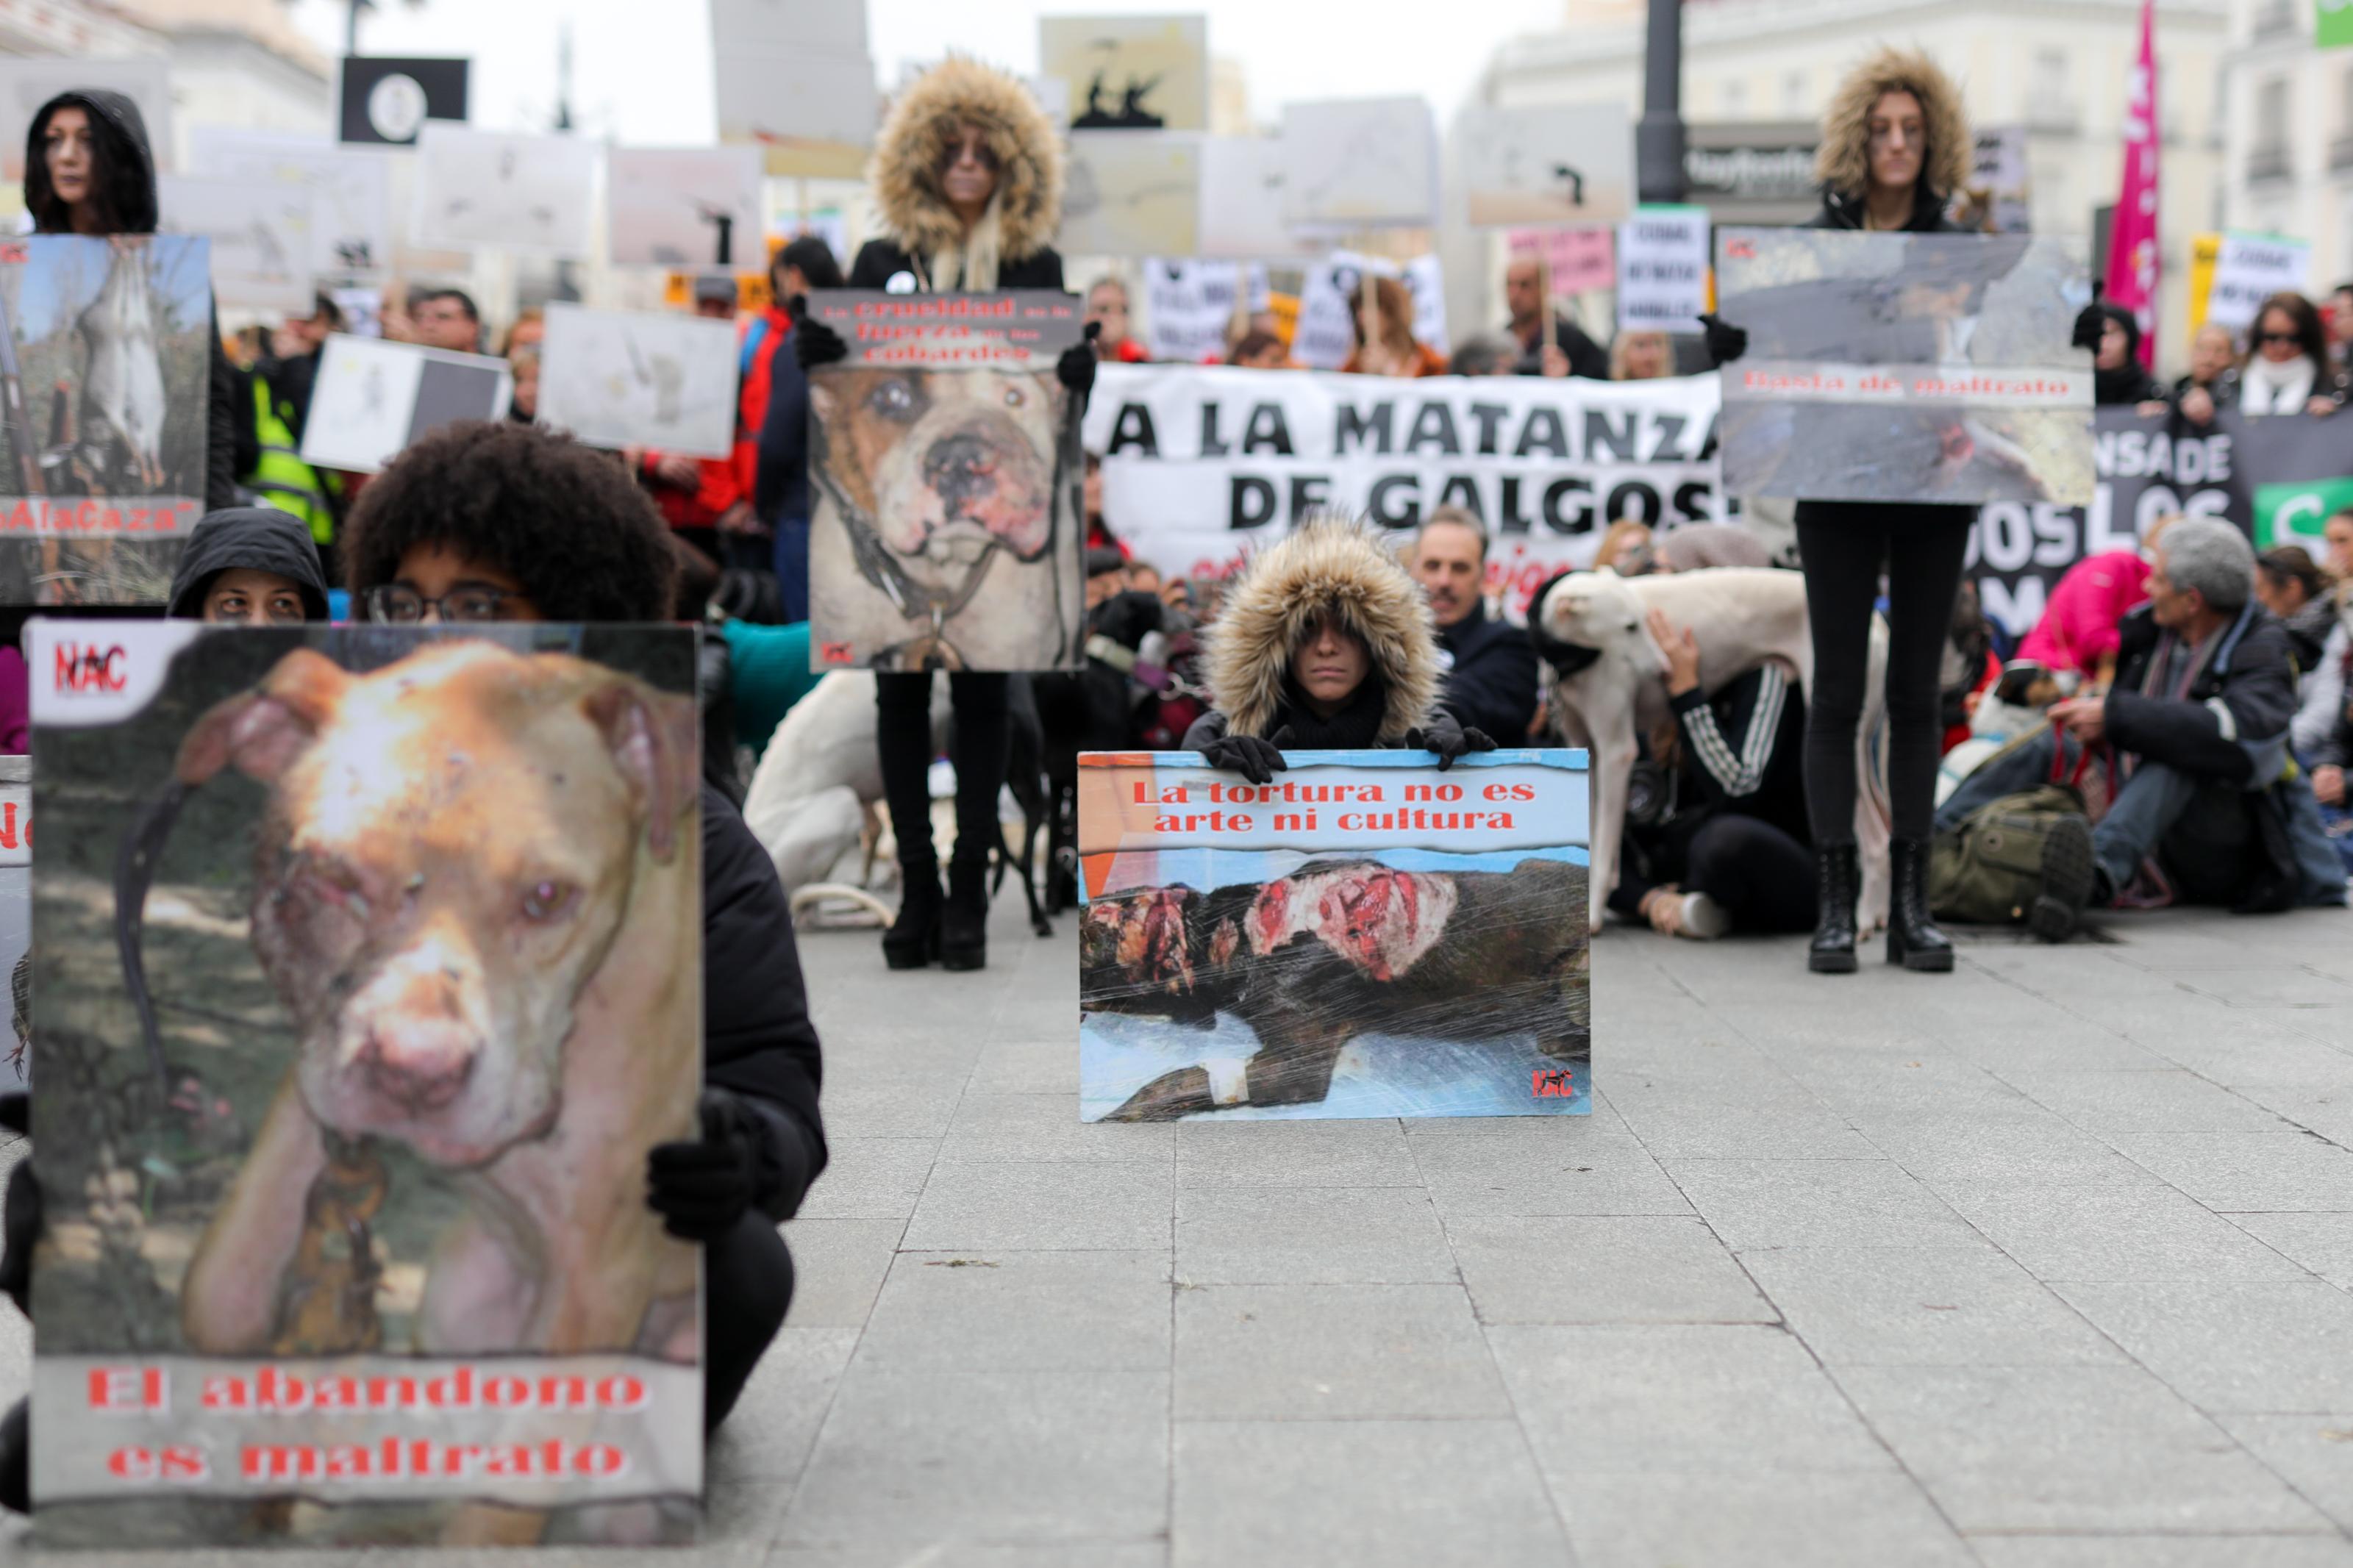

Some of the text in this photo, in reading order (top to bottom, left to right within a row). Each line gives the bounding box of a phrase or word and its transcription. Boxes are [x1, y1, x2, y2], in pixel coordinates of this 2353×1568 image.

[854, 296, 1015, 318] crueldad
[855, 322, 971, 341] fuerza
[863, 343, 1031, 365] cobardes
[1743, 370, 2069, 395] Basta de maltrato
[1108, 401, 1160, 457] A
[1202, 403, 1294, 455] LA
[1230, 476, 1712, 534] DE GALGOS
[53, 641, 128, 692] NAC
[1133, 780, 1536, 804] La tortura no es
[1153, 807, 1516, 832] arte ni cultura
[1532, 1070, 1574, 1098] NAC
[88, 1366, 647, 1409] El abandono
[107, 1436, 626, 1478] es maltrato
